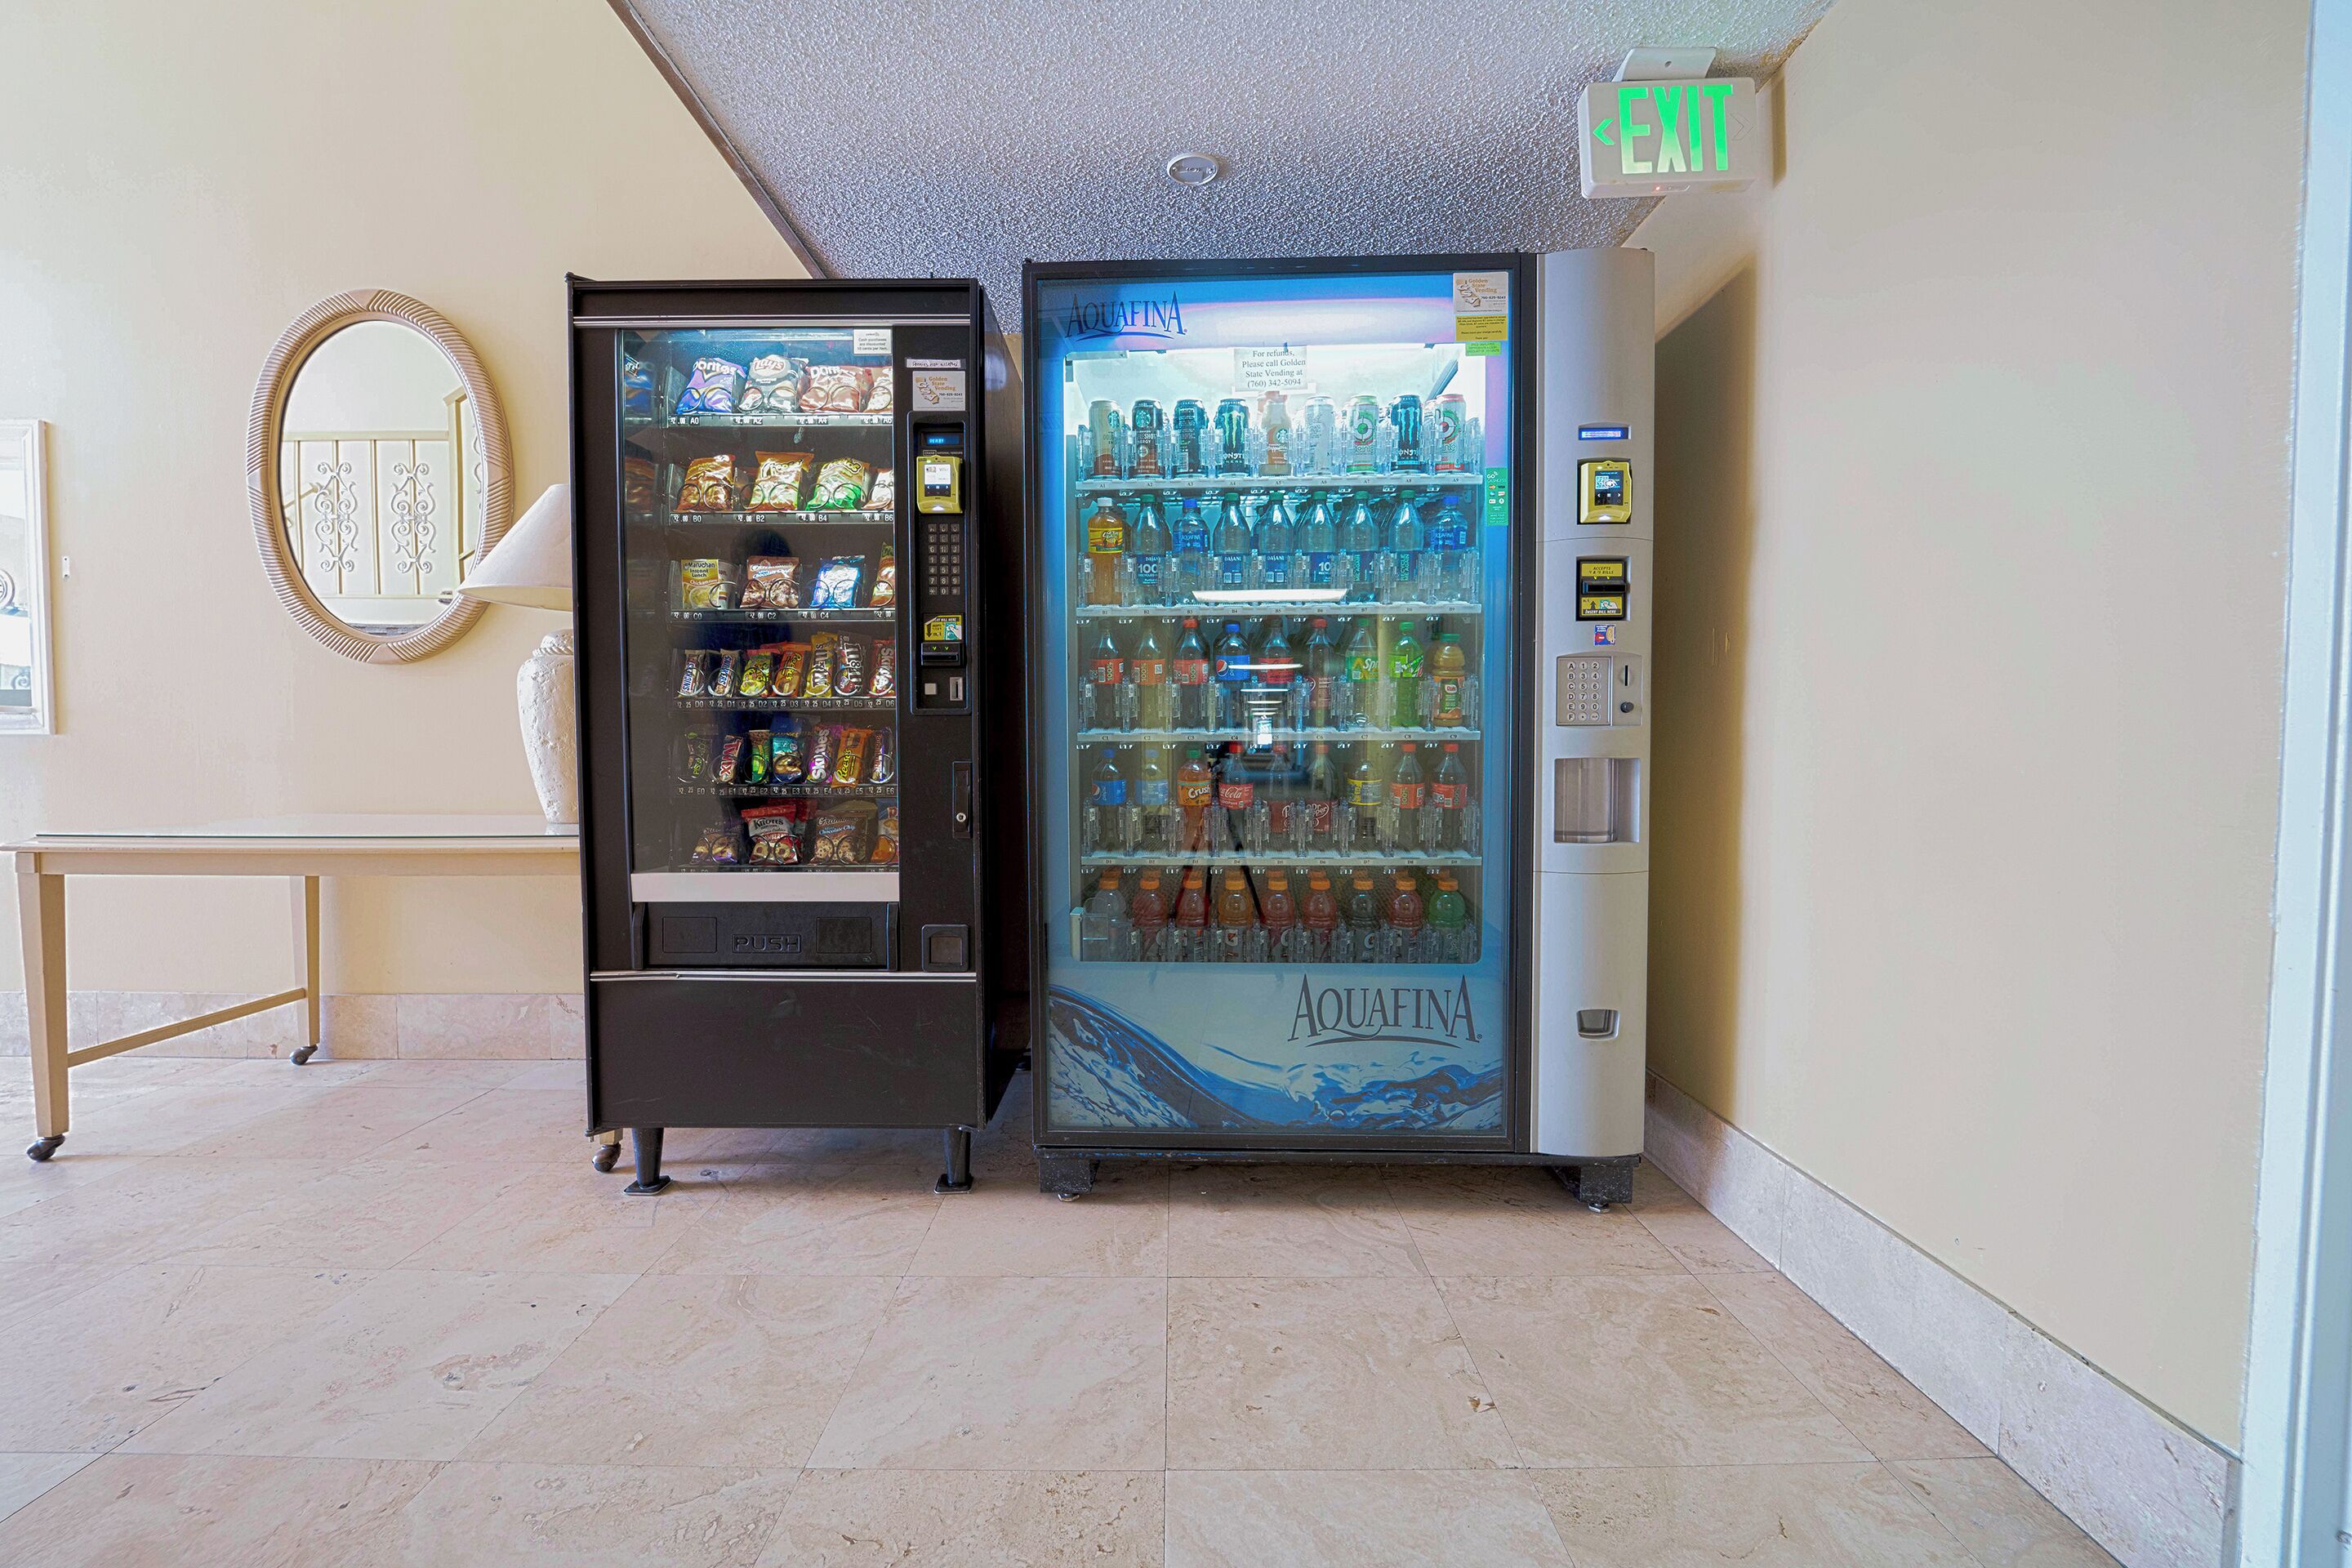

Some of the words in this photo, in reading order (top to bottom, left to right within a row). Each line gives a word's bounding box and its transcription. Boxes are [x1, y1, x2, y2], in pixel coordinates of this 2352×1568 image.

[1618, 84, 1733, 175] EXIT
[1065, 291, 1186, 339] AQUAFINA
[1242, 360, 1263, 368] Please
[1245, 370, 1263, 378] State
[1265, 369, 1294, 378] Vending
[1247, 381, 1267, 389] (760)
[1268, 378, 1302, 387] 342-5094
[693, 514, 702, 523] B0
[755, 514, 765, 523] B2
[1138, 564, 1158, 573] 100
[767, 612, 777, 620] C2
[683, 662, 695, 691] SNICKERS
[789, 700, 799, 708] D3
[819, 827, 843, 835] Chocolate
[735, 934, 800, 952] PUSH
[1287, 973, 1480, 1044] AQUAFINA
